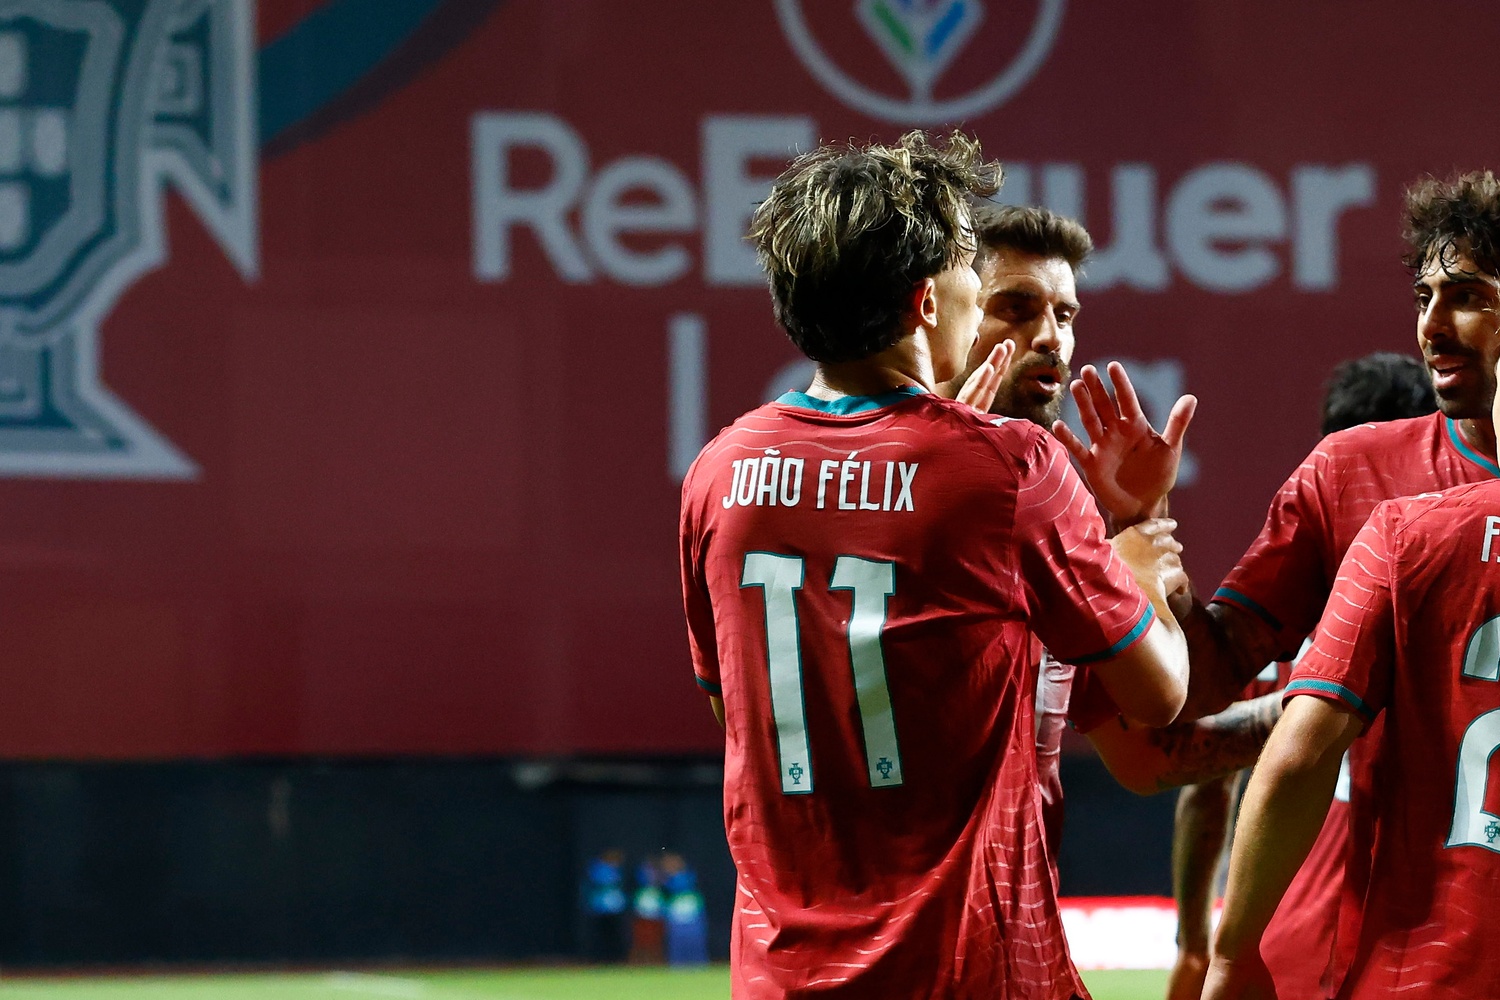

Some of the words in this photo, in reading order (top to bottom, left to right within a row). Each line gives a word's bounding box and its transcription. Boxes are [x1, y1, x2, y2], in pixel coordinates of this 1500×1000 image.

[469, 110, 1376, 293] ReEuer
[722, 448, 804, 510] JOÃO
[816, 451, 919, 512] FÉLIX
[739, 550, 904, 795] 11
